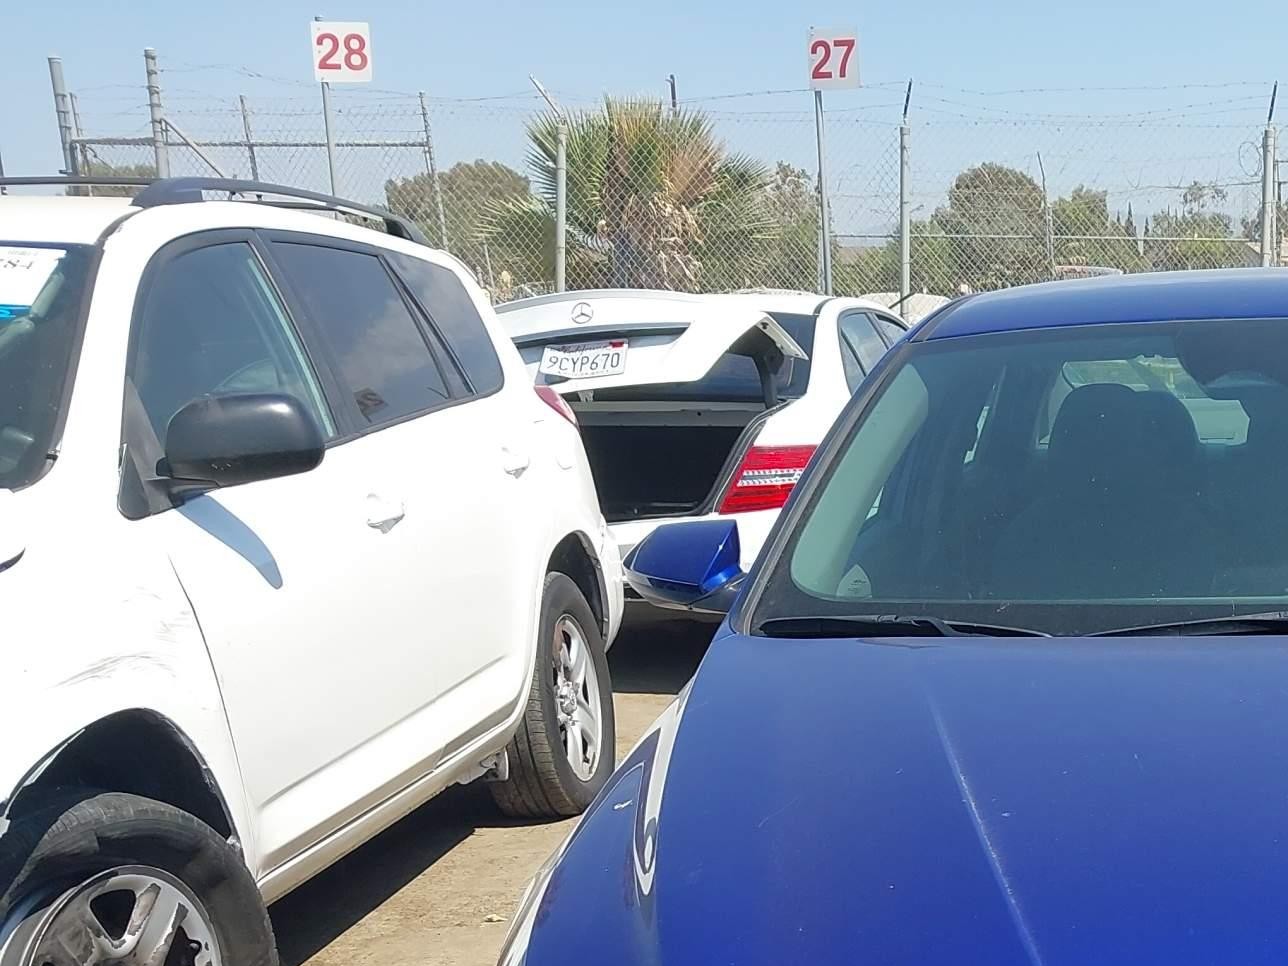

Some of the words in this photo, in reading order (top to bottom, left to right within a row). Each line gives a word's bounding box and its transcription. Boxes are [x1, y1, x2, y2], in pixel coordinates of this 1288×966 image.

[315, 32, 369, 71] 28
[810, 38, 856, 80] 27
[547, 352, 620, 373] 9CYP670
